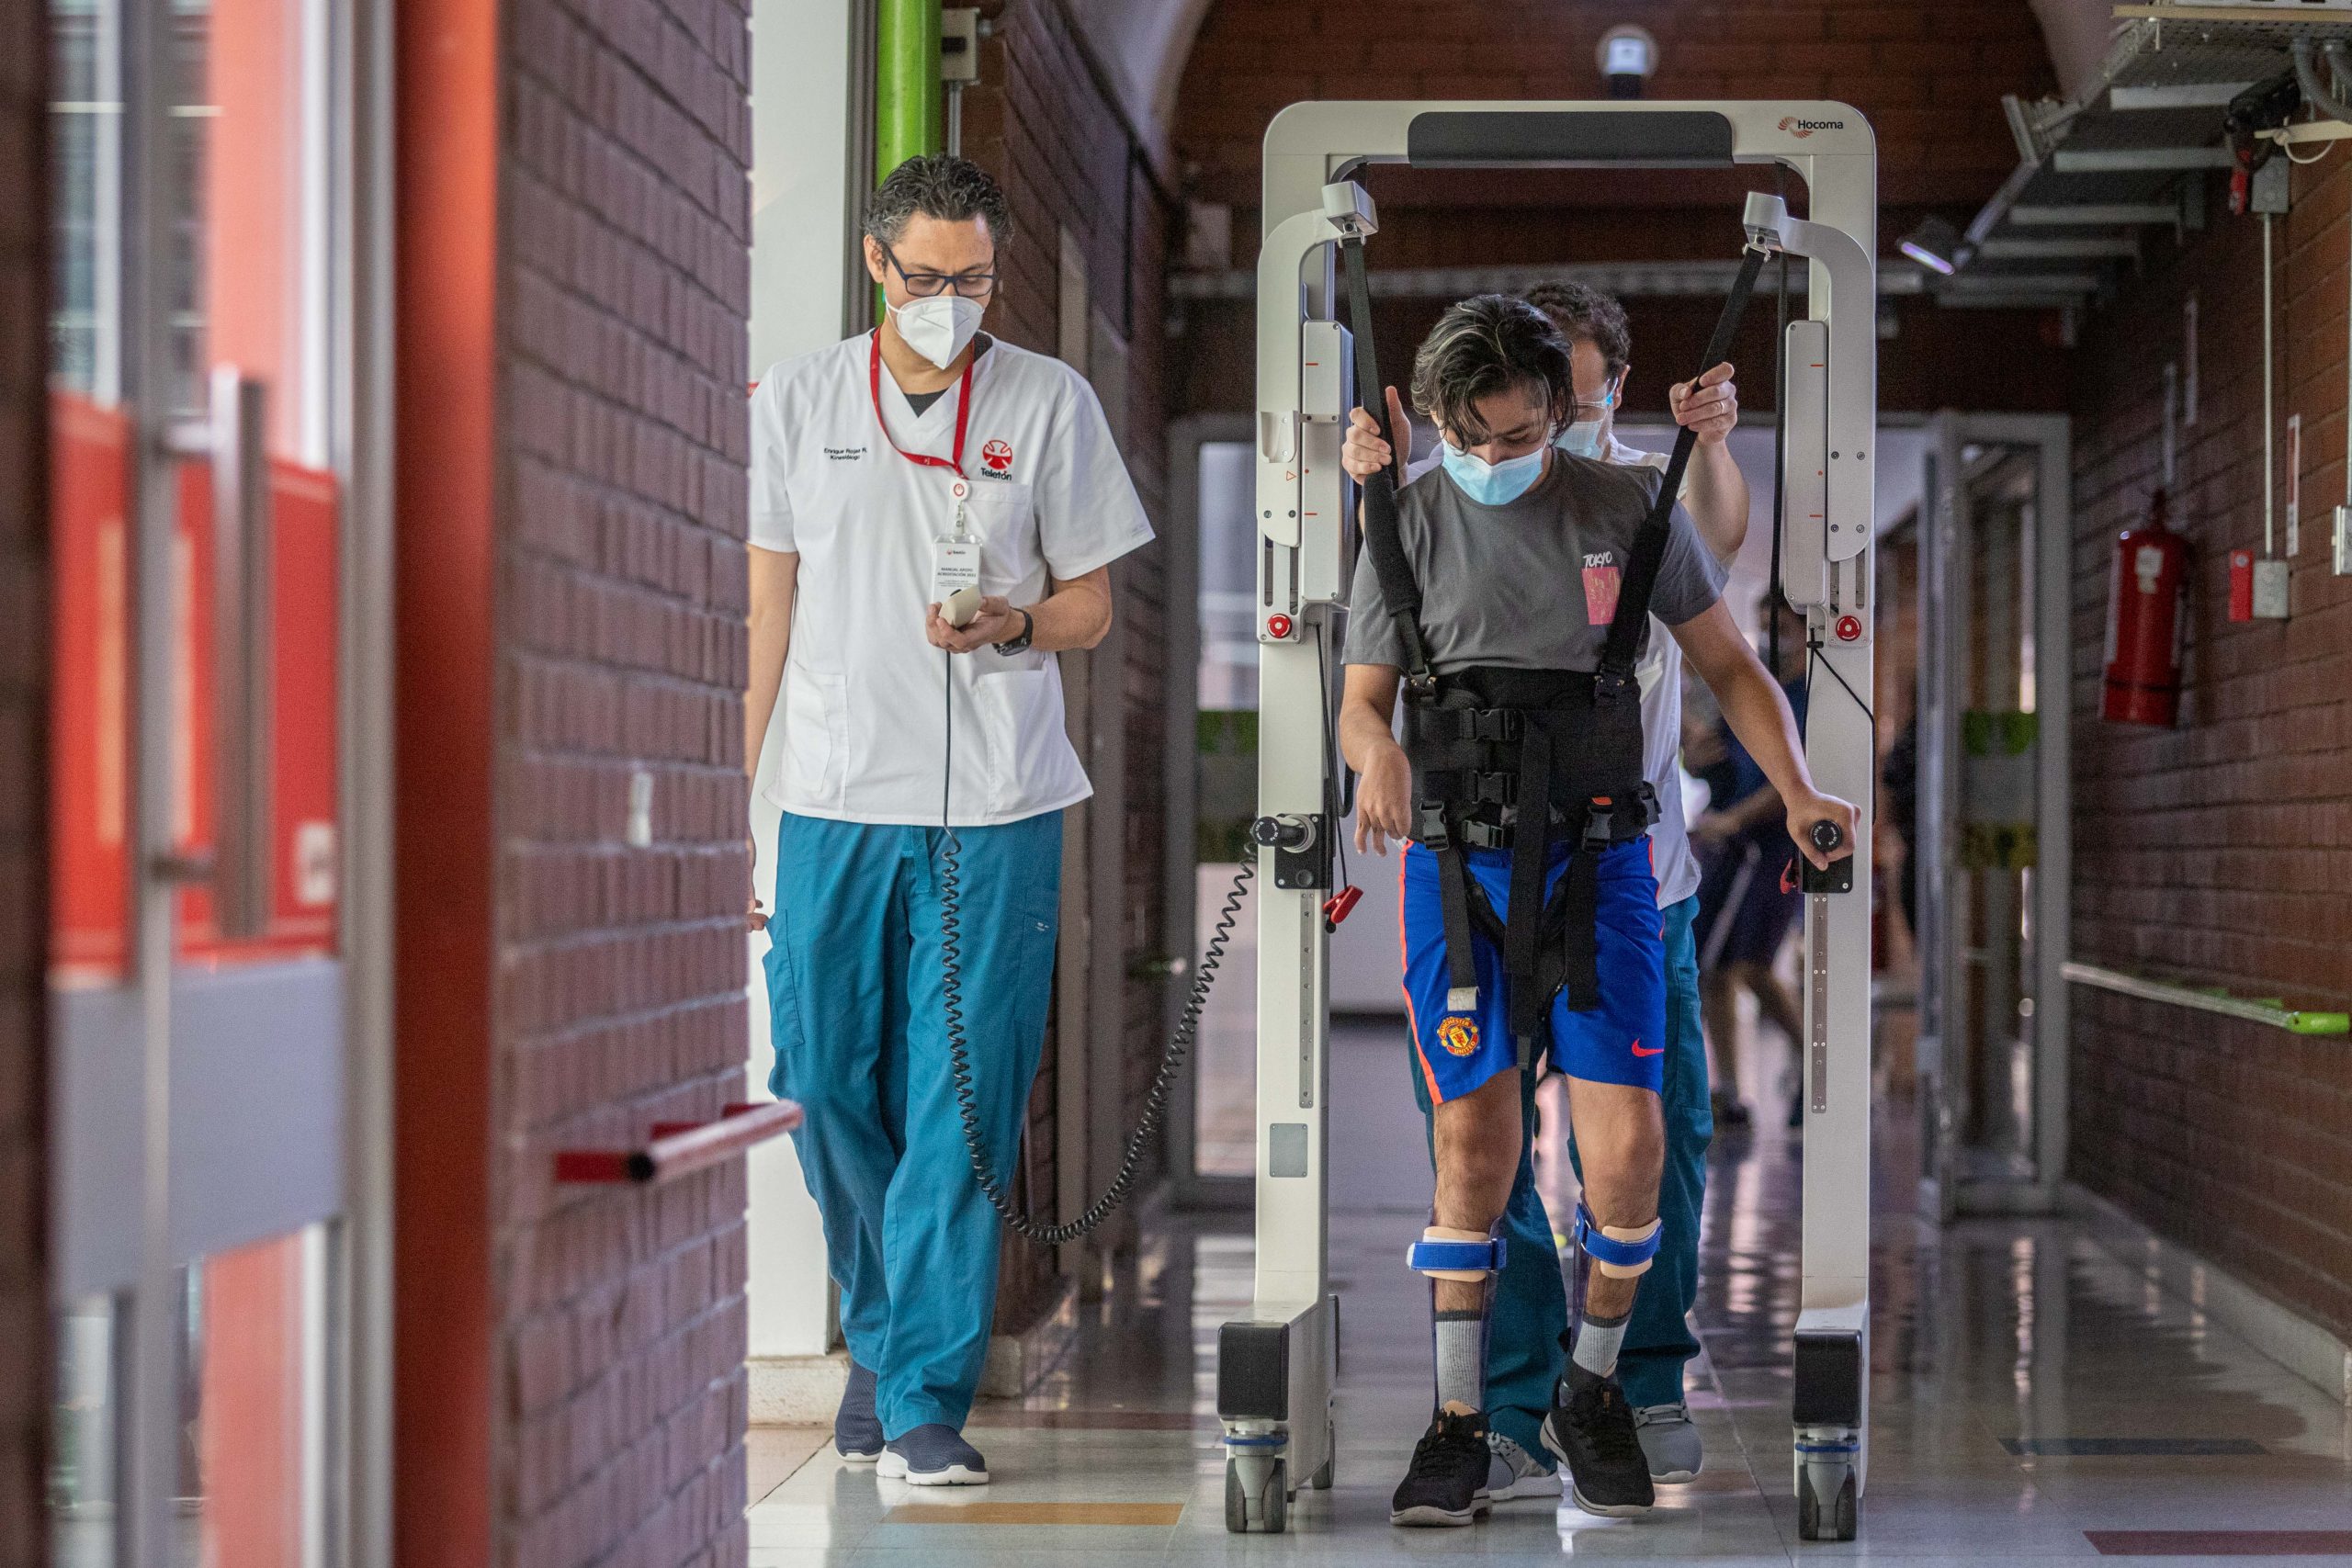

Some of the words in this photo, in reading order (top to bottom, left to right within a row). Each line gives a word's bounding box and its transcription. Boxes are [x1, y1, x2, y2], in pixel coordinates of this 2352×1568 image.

[1797, 119, 1844, 130] Hocoma
[980, 467, 1012, 481] Teletón
[1583, 551, 1612, 571] TOKYO
